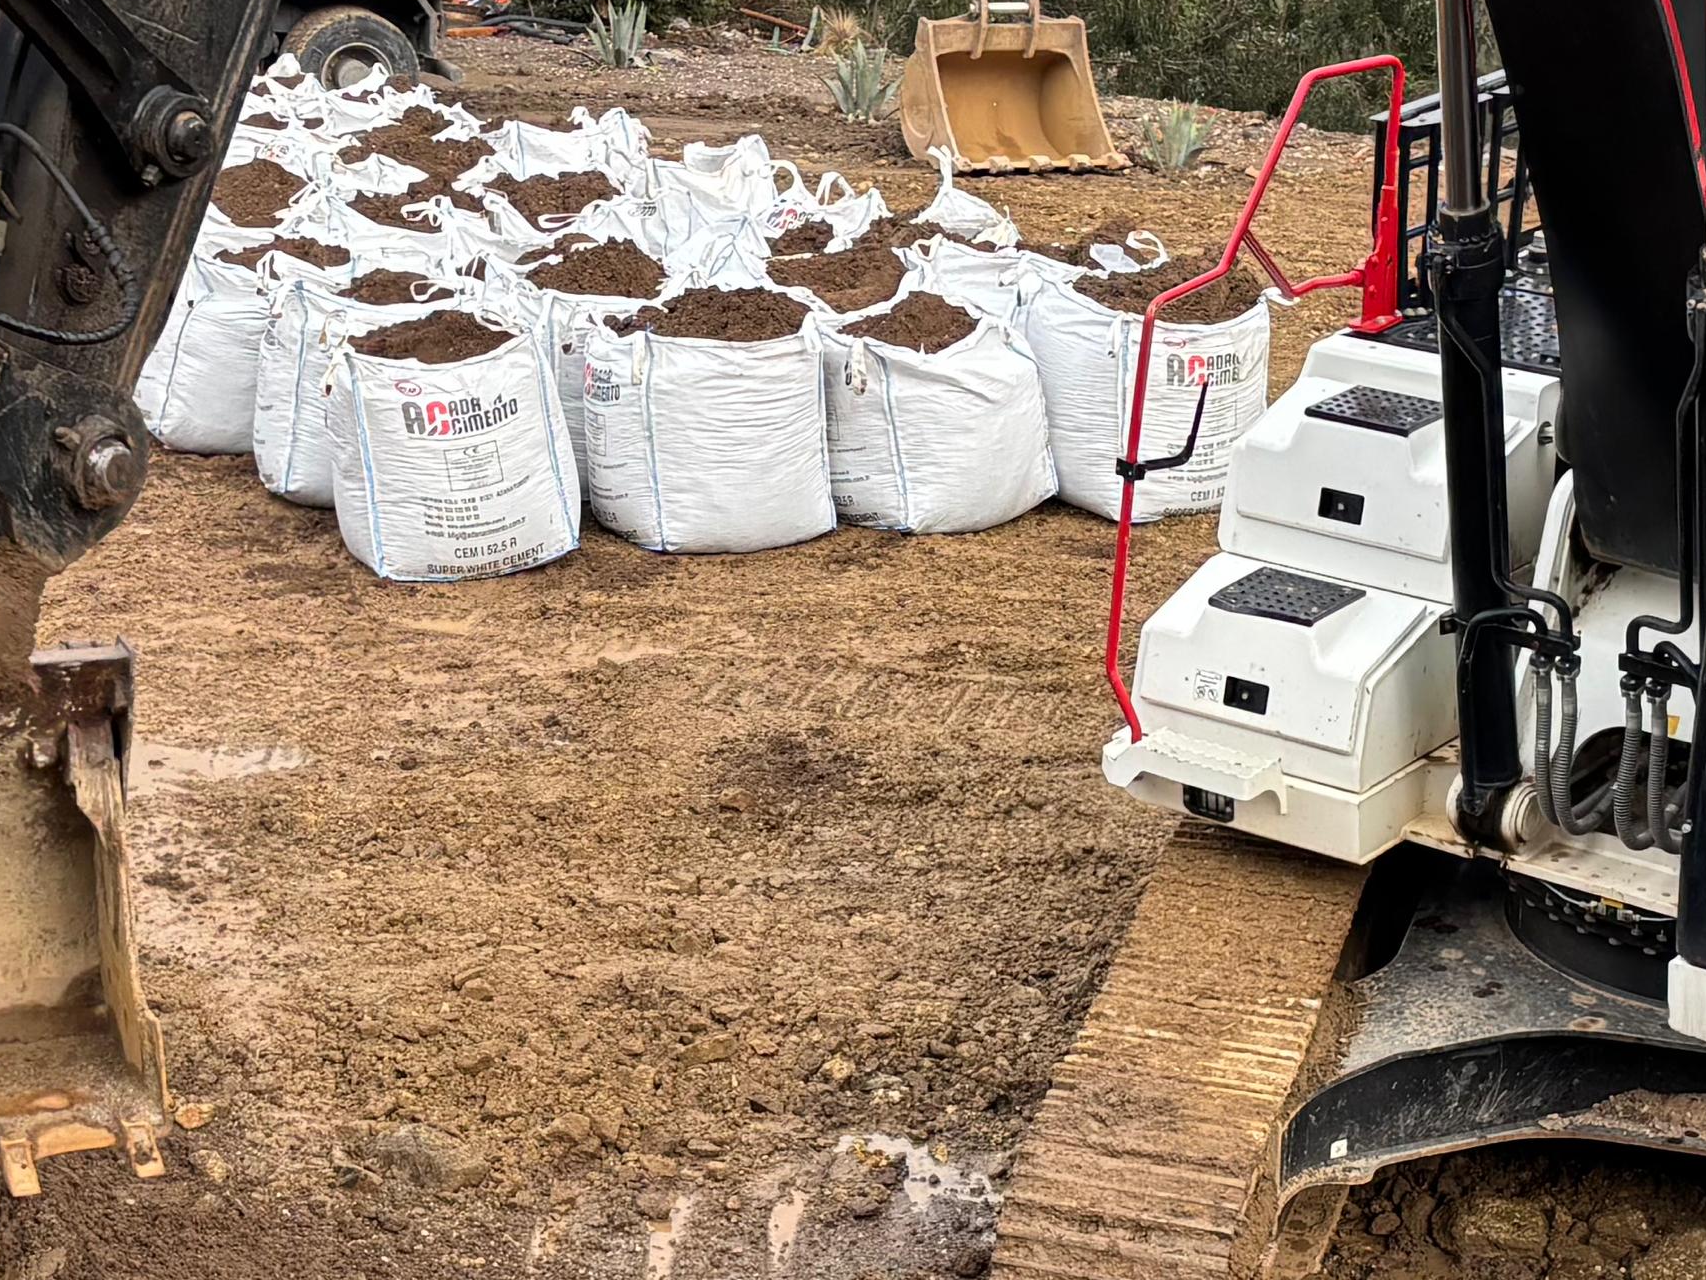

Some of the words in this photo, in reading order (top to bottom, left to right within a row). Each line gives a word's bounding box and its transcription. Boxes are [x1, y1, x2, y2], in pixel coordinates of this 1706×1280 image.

[427, 563, 465, 575] SUPER
[466, 558, 500, 574] WHITE
[502, 542, 546, 568] CEMENT
[454, 546, 479, 559] CEM
[509, 536, 518, 549] R
